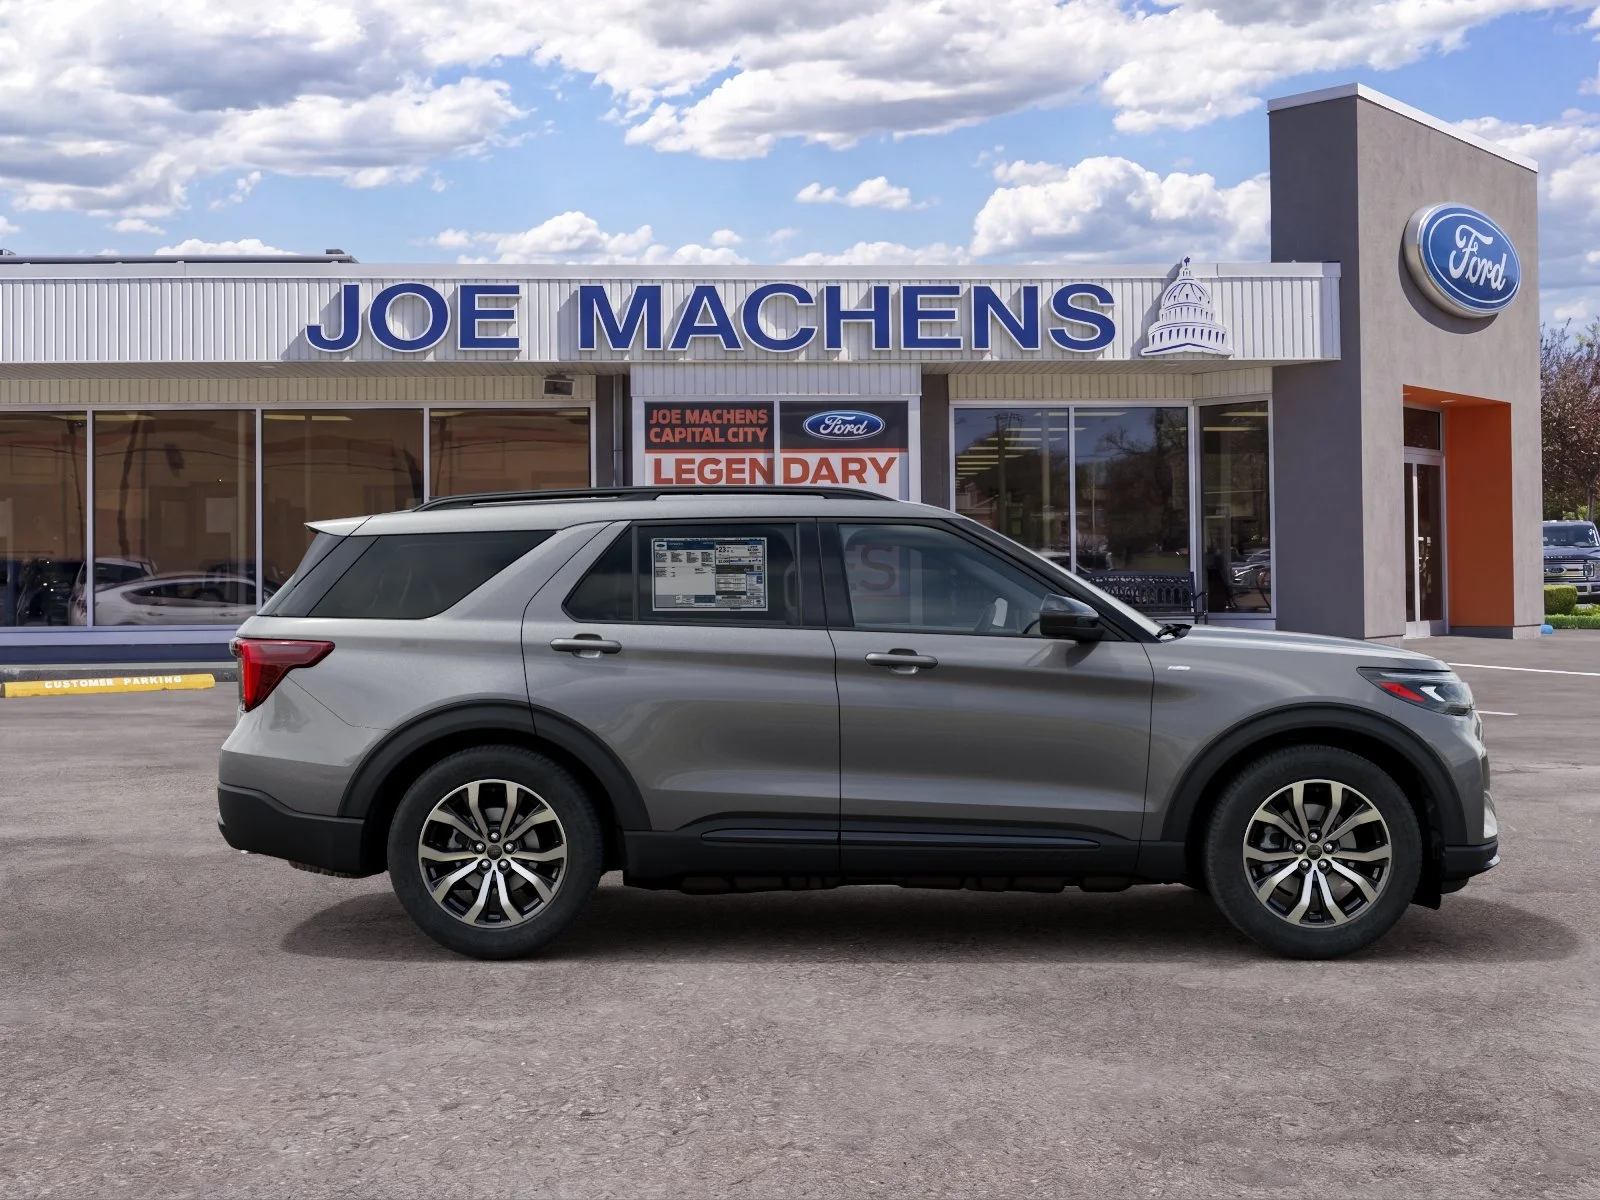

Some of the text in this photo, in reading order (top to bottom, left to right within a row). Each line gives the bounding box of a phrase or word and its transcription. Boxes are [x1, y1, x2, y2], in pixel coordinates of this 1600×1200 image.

[1449, 224, 1508, 291] Ford
[305, 282, 1116, 352] JOE MACHENS
[650, 409, 769, 425] JOE MACHENS
[820, 415, 867, 435] Ford
[650, 427, 768, 443] CAPITAL CITY
[44, 675, 182, 689] CUSTOMER PARKING
